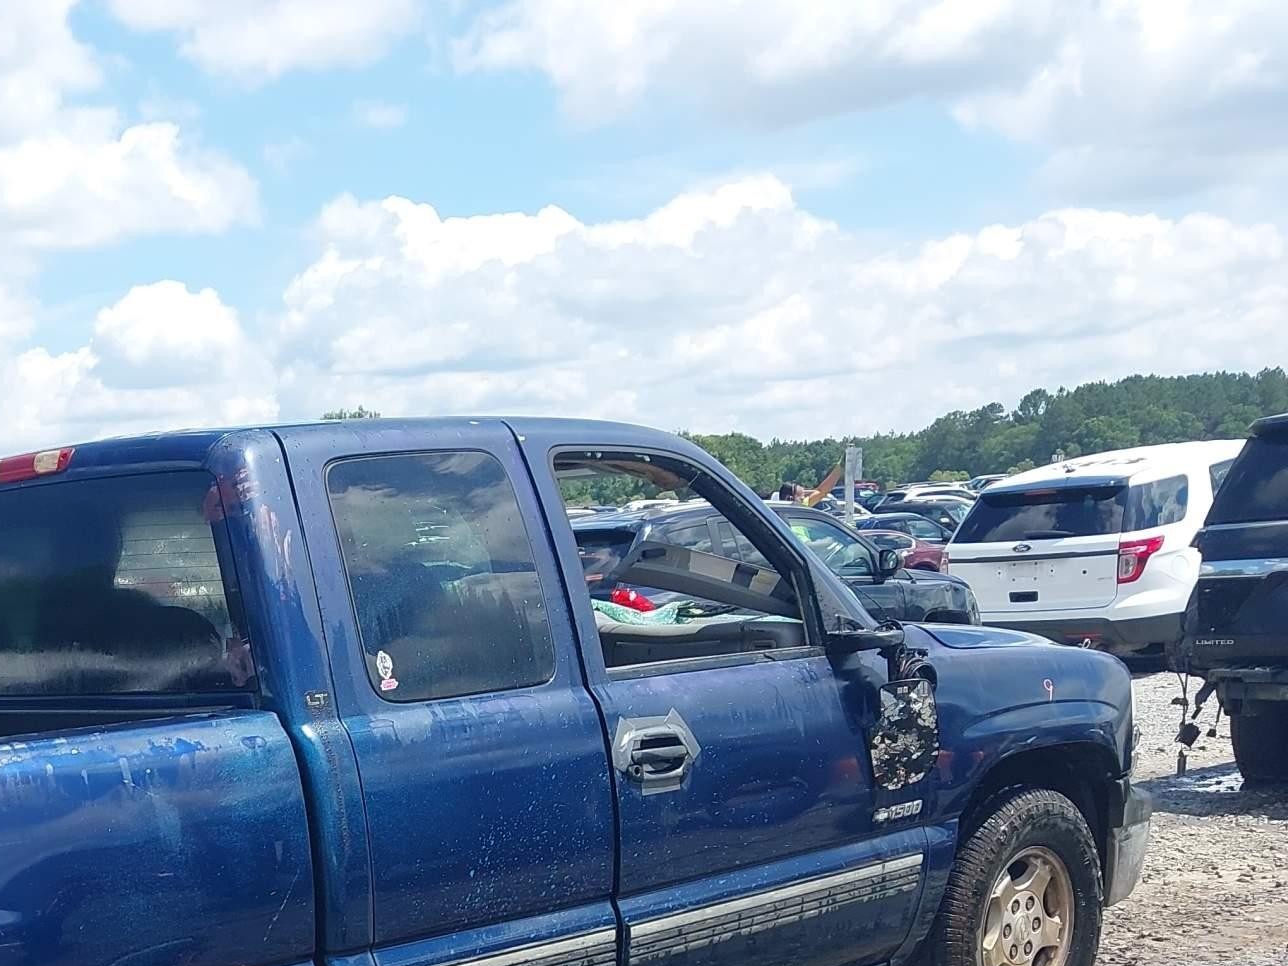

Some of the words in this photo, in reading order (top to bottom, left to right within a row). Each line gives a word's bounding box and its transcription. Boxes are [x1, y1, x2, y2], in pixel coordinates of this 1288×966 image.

[306, 693, 328, 706] LT
[1043, 678, 1053, 702] 9
[889, 799, 923, 820] 1500
